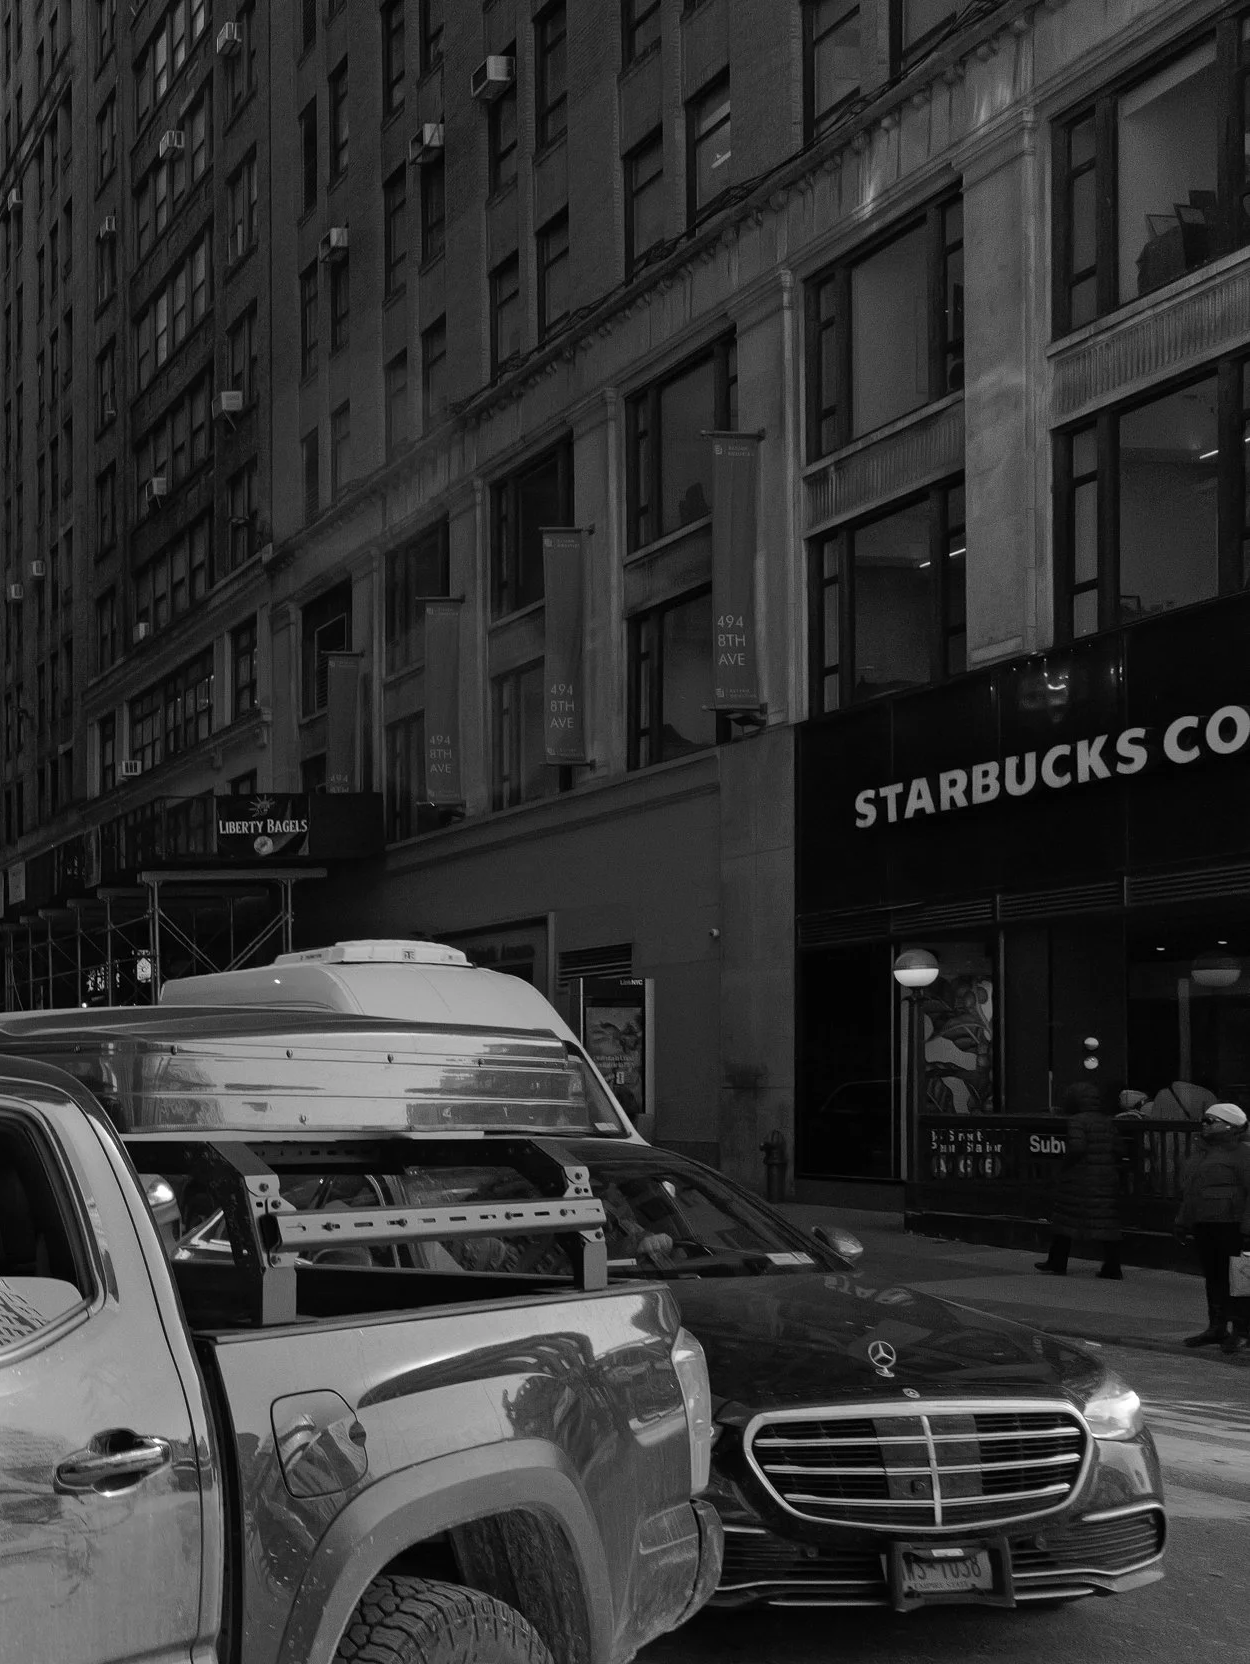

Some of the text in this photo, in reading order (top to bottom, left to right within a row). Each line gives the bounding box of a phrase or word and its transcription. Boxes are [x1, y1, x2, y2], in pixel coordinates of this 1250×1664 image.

[717, 615, 744, 628] 494
[717, 634, 746, 647] 8TH
[717, 653, 746, 666] AVE
[550, 684, 574, 696] 494
[550, 701, 575, 713] 8TH
[550, 717, 575, 729] AVE
[430, 735, 451, 745] 494
[430, 749, 452, 759] 8TH
[430, 763, 452, 774] AVE
[854, 705, 1250, 829] STARBUCKS CO
[219, 818, 308, 835] LIBERTY BAGELS
